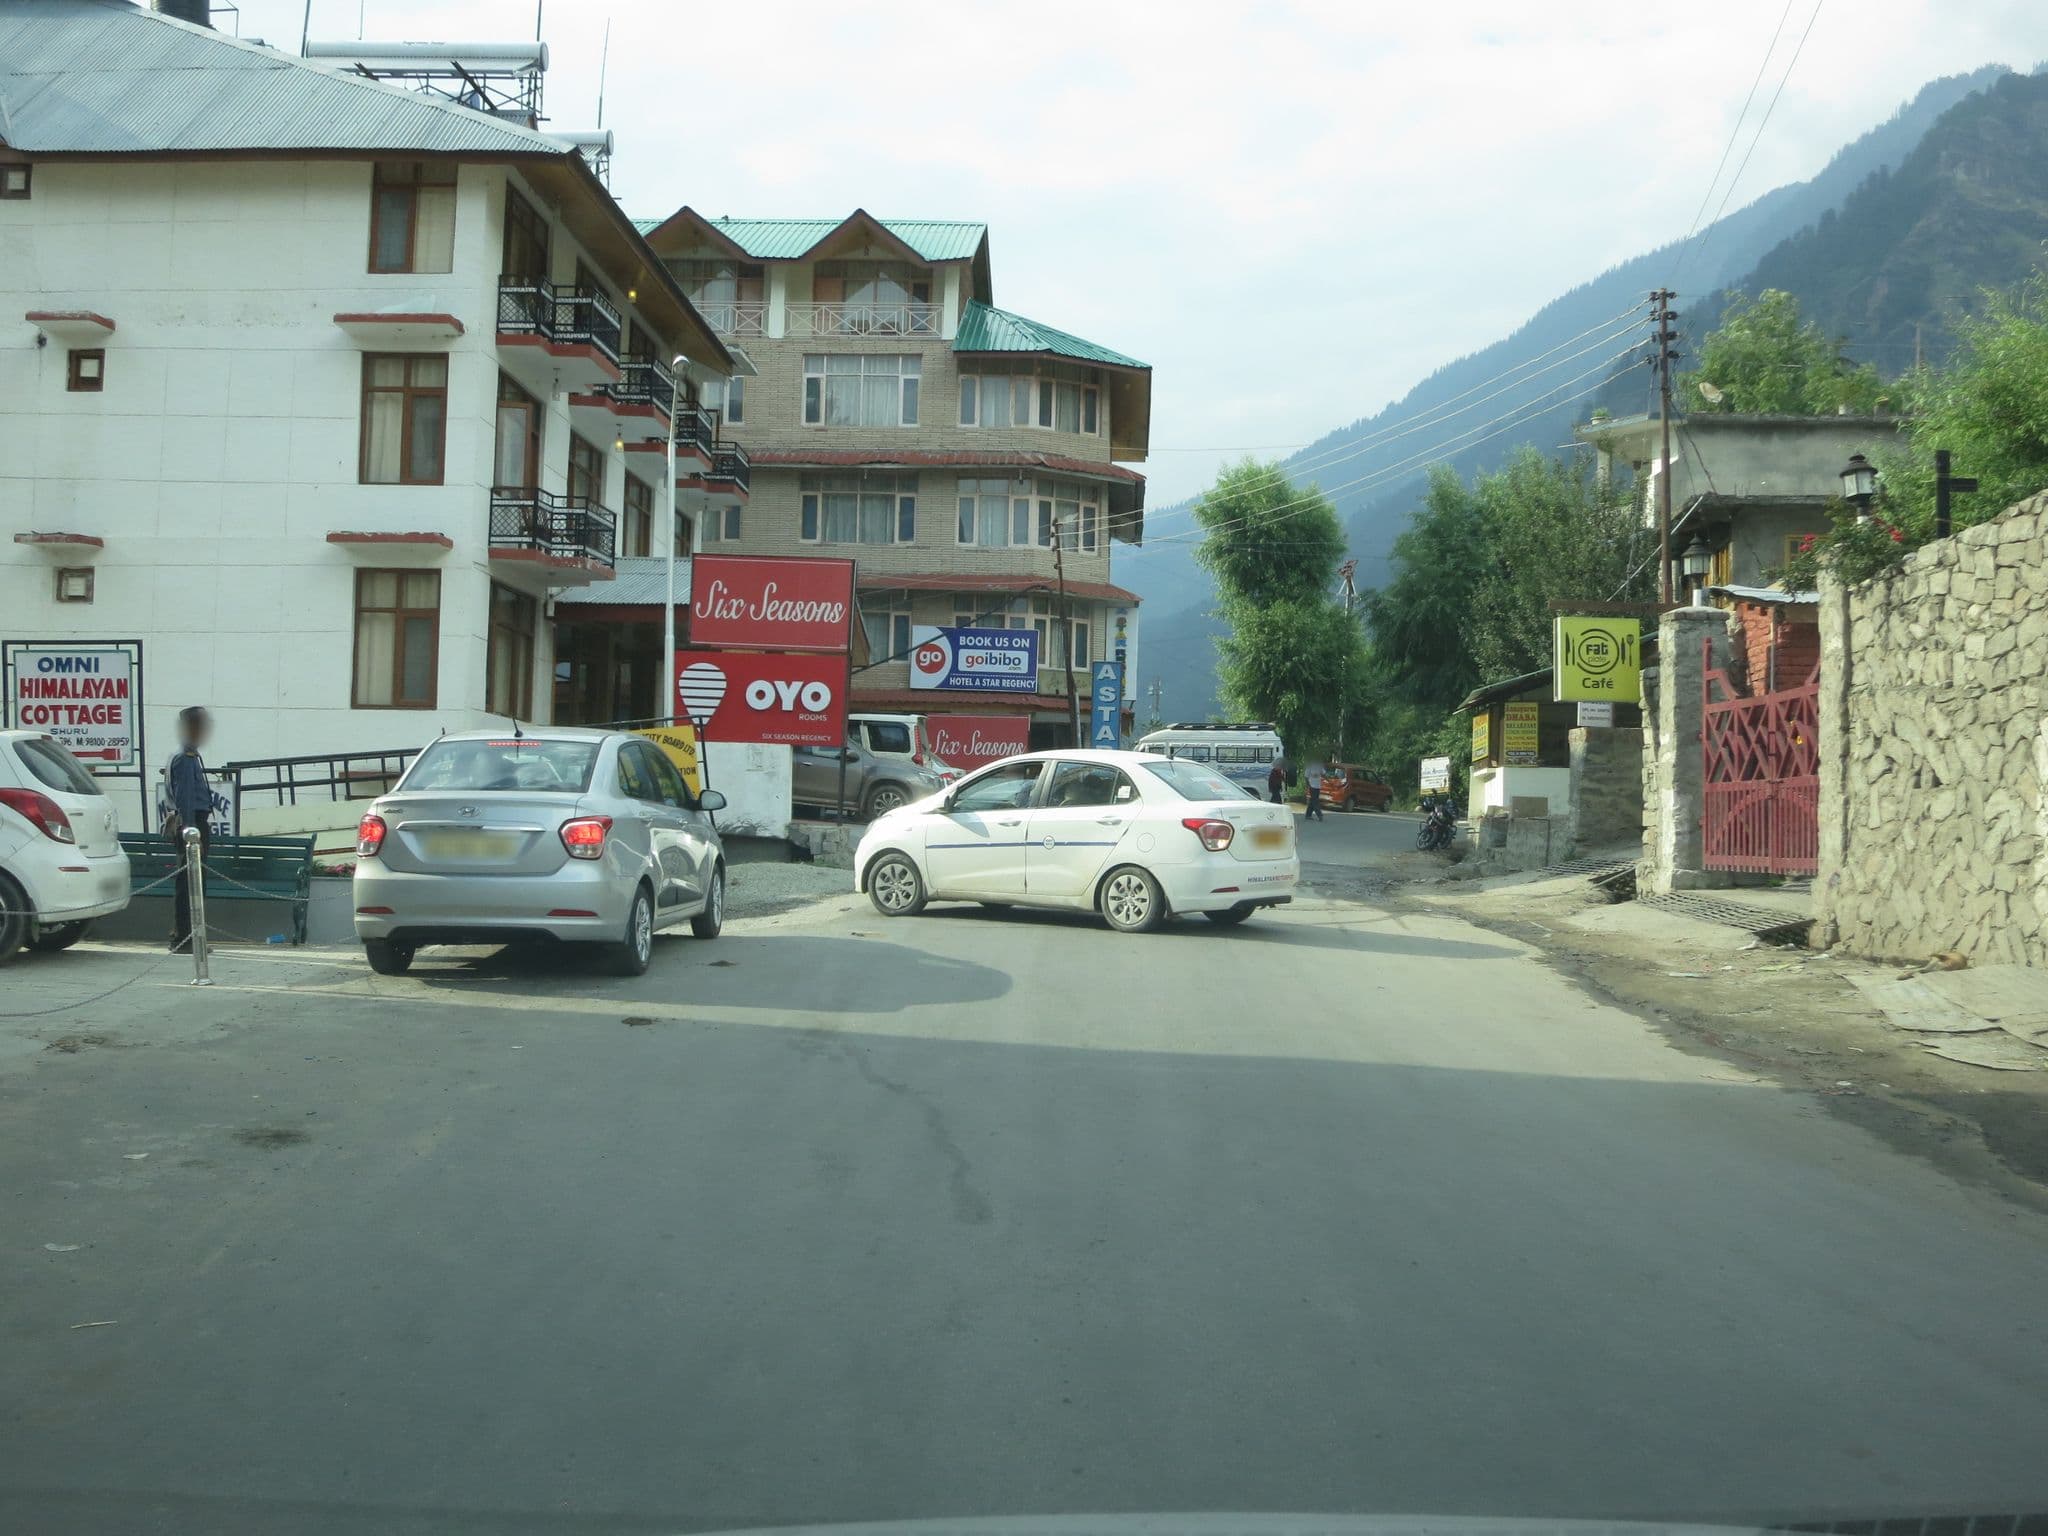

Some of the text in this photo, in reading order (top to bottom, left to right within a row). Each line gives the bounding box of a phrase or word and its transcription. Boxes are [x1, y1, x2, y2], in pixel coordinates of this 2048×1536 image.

[696, 580, 846, 623] Six Seasons
[960, 636, 1030, 648] BOOK US ON
[38, 657, 99, 673] OMNI
[919, 651, 942, 667] go
[965, 652, 1021, 668] goibibo
[20, 678, 129, 699] HIMALAYAN
[949, 677, 1036, 688] HOTEL A STAR REGENCY
[1582, 677, 1614, 689] Café
[746, 679, 832, 712] OYO
[21, 704, 122, 725] COTTAGE
[799, 713, 828, 721] ROOMS
[662, 735, 685, 750] BOARD
[683, 744, 696, 755] LTD
[929, 729, 1026, 756] Six Seasons
